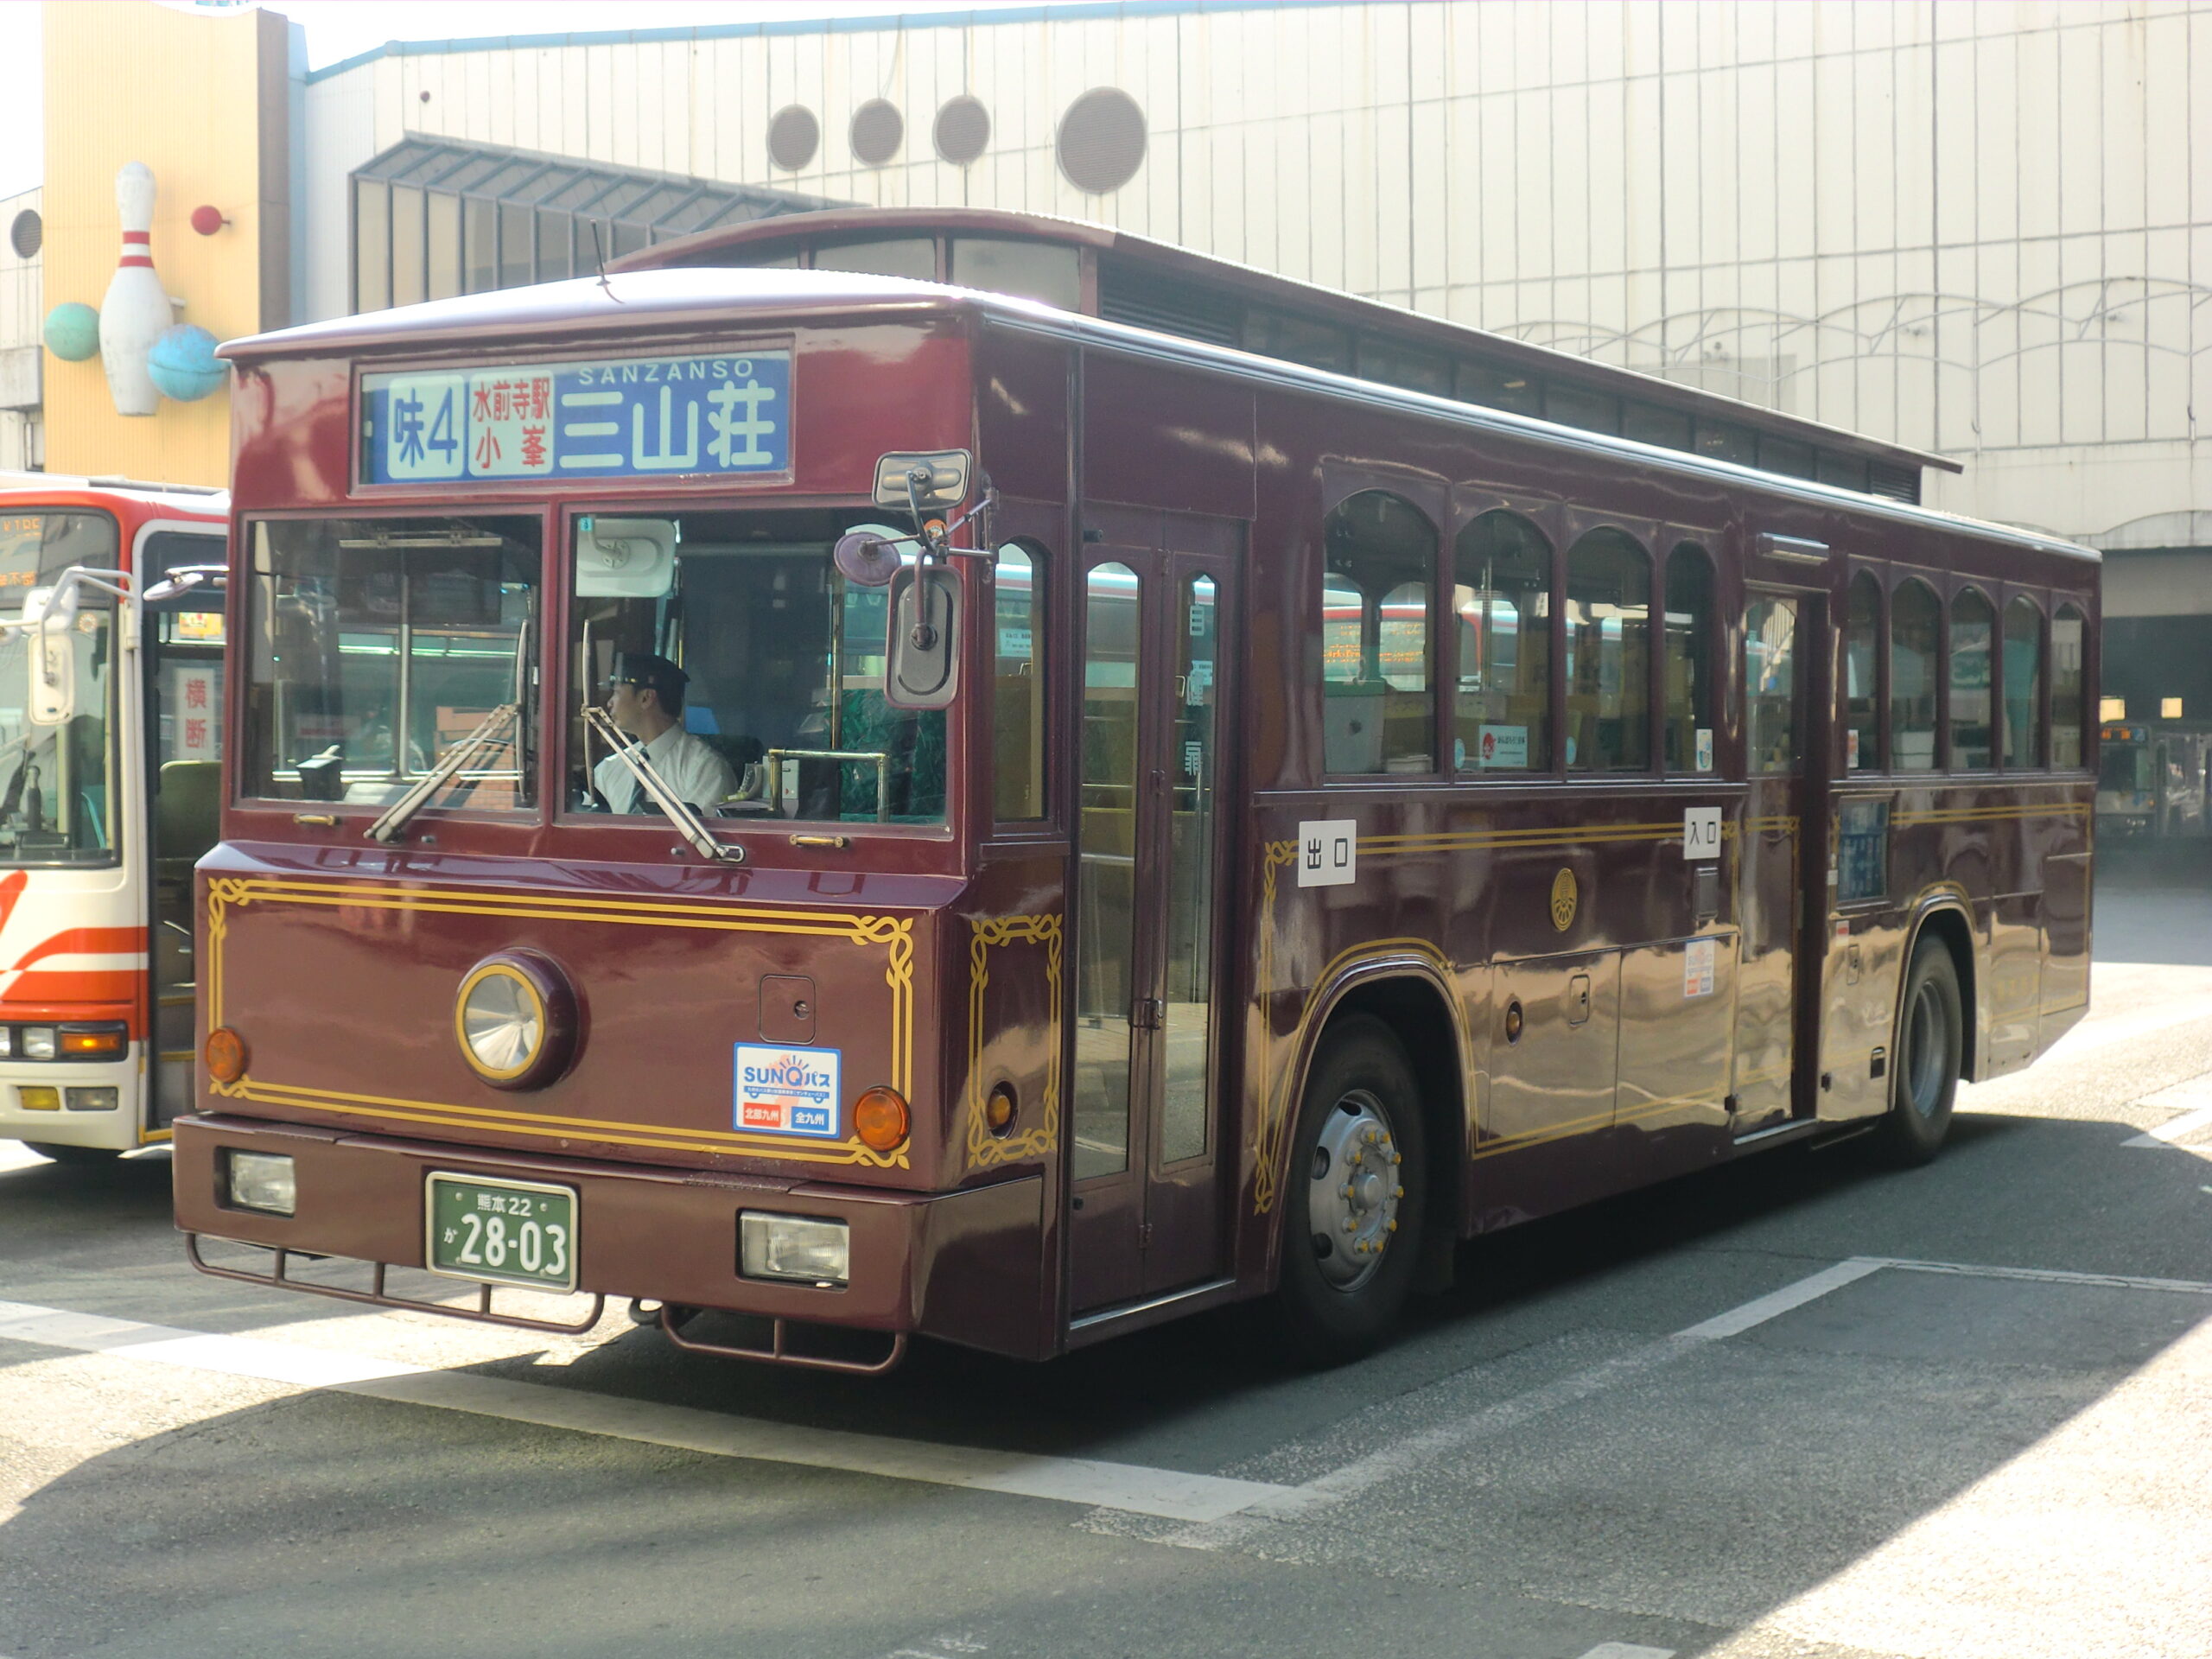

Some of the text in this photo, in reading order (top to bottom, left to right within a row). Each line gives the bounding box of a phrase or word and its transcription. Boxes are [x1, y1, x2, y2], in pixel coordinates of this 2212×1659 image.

[579, 359, 753, 385] SANZANSO
[473, 377, 551, 422] 水前寺駅
[394, 386, 458, 467] 味4
[561, 378, 776, 469] 三山荘
[185, 678, 207, 760] 横断
[1689, 821, 1717, 846] 入口
[1307, 837, 1348, 869] 出口
[745, 1108, 779, 1122] 北部九州
[795, 1111, 824, 1126] 全九州
[461, 1213, 566, 1275] 28-03
